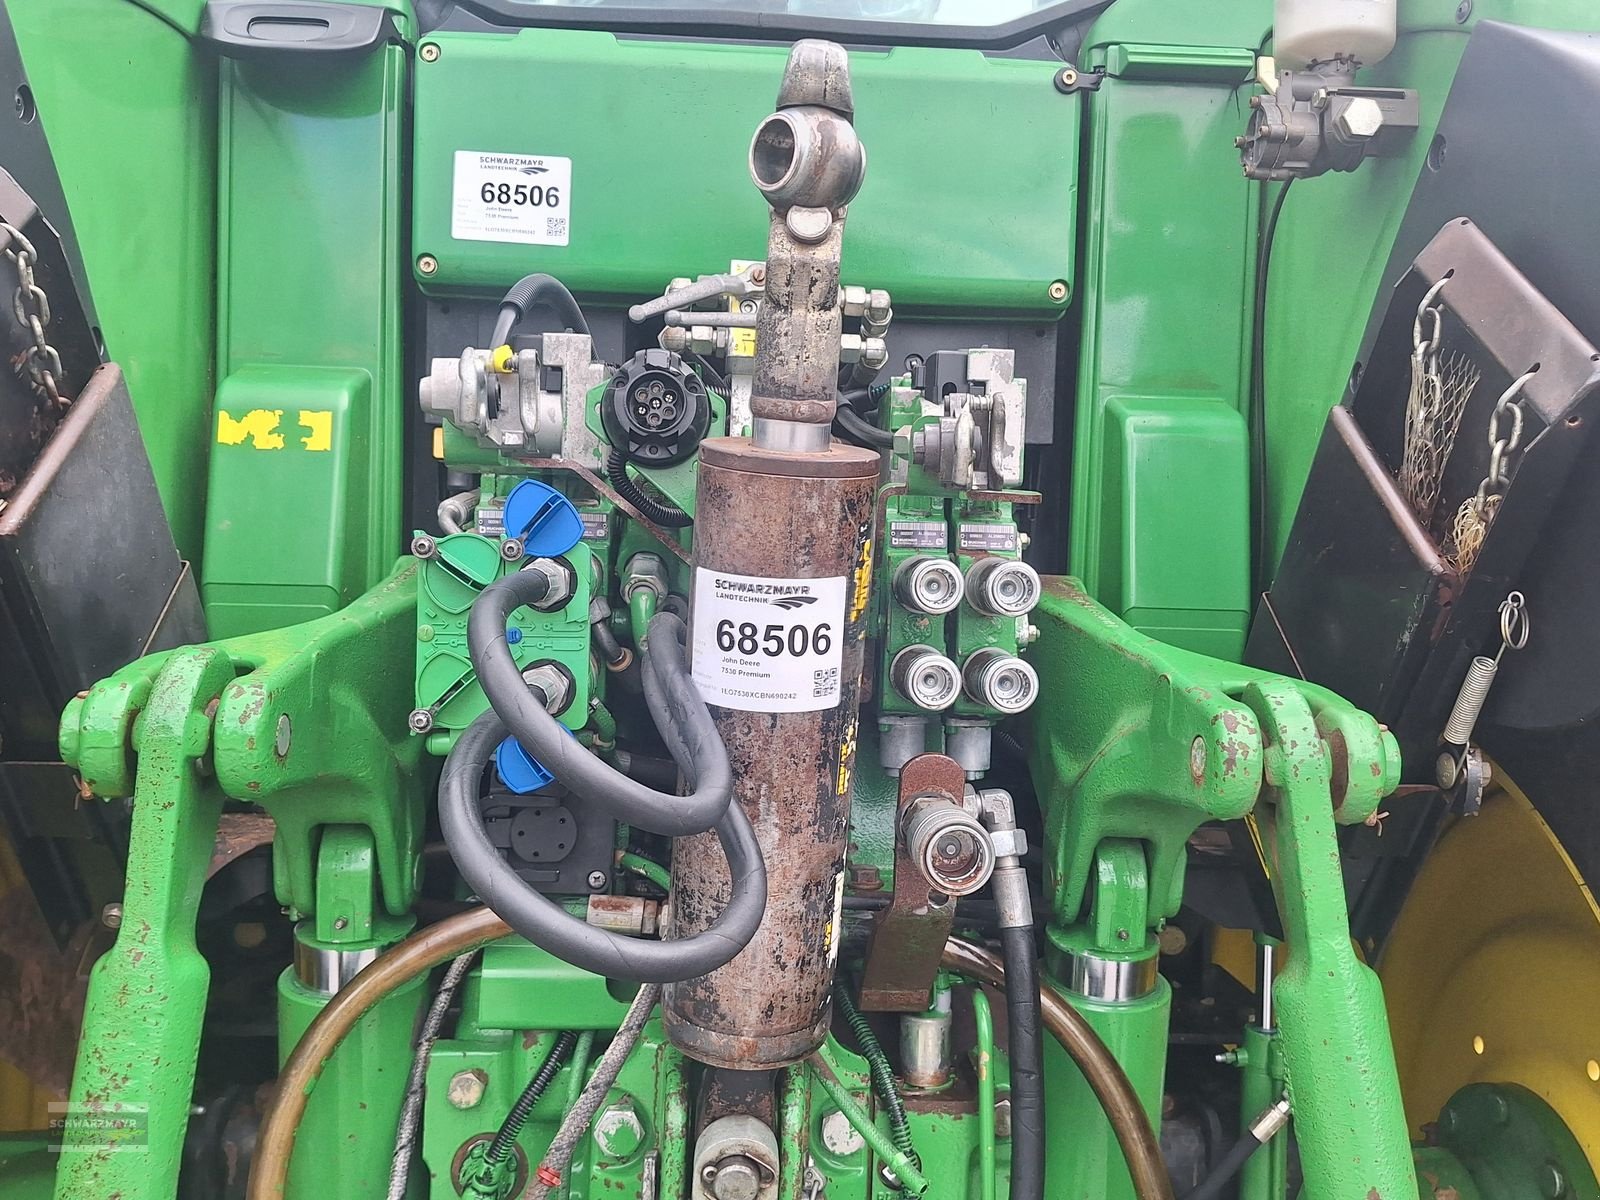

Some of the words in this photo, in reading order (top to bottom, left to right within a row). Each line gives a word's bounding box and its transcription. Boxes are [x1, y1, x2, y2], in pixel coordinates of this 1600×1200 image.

[479, 156, 544, 166] SCHWARZMAYR
[481, 182, 560, 208] 68506
[715, 578, 811, 595] SCHWARZMAYR
[715, 592, 769, 604] LANDTECHNIK
[716, 619, 832, 657] 68506
[721, 656, 738, 665] John
[739, 658, 761, 668] Deere
[721, 667, 737, 676] 7530
[738, 668, 771, 679] Premium
